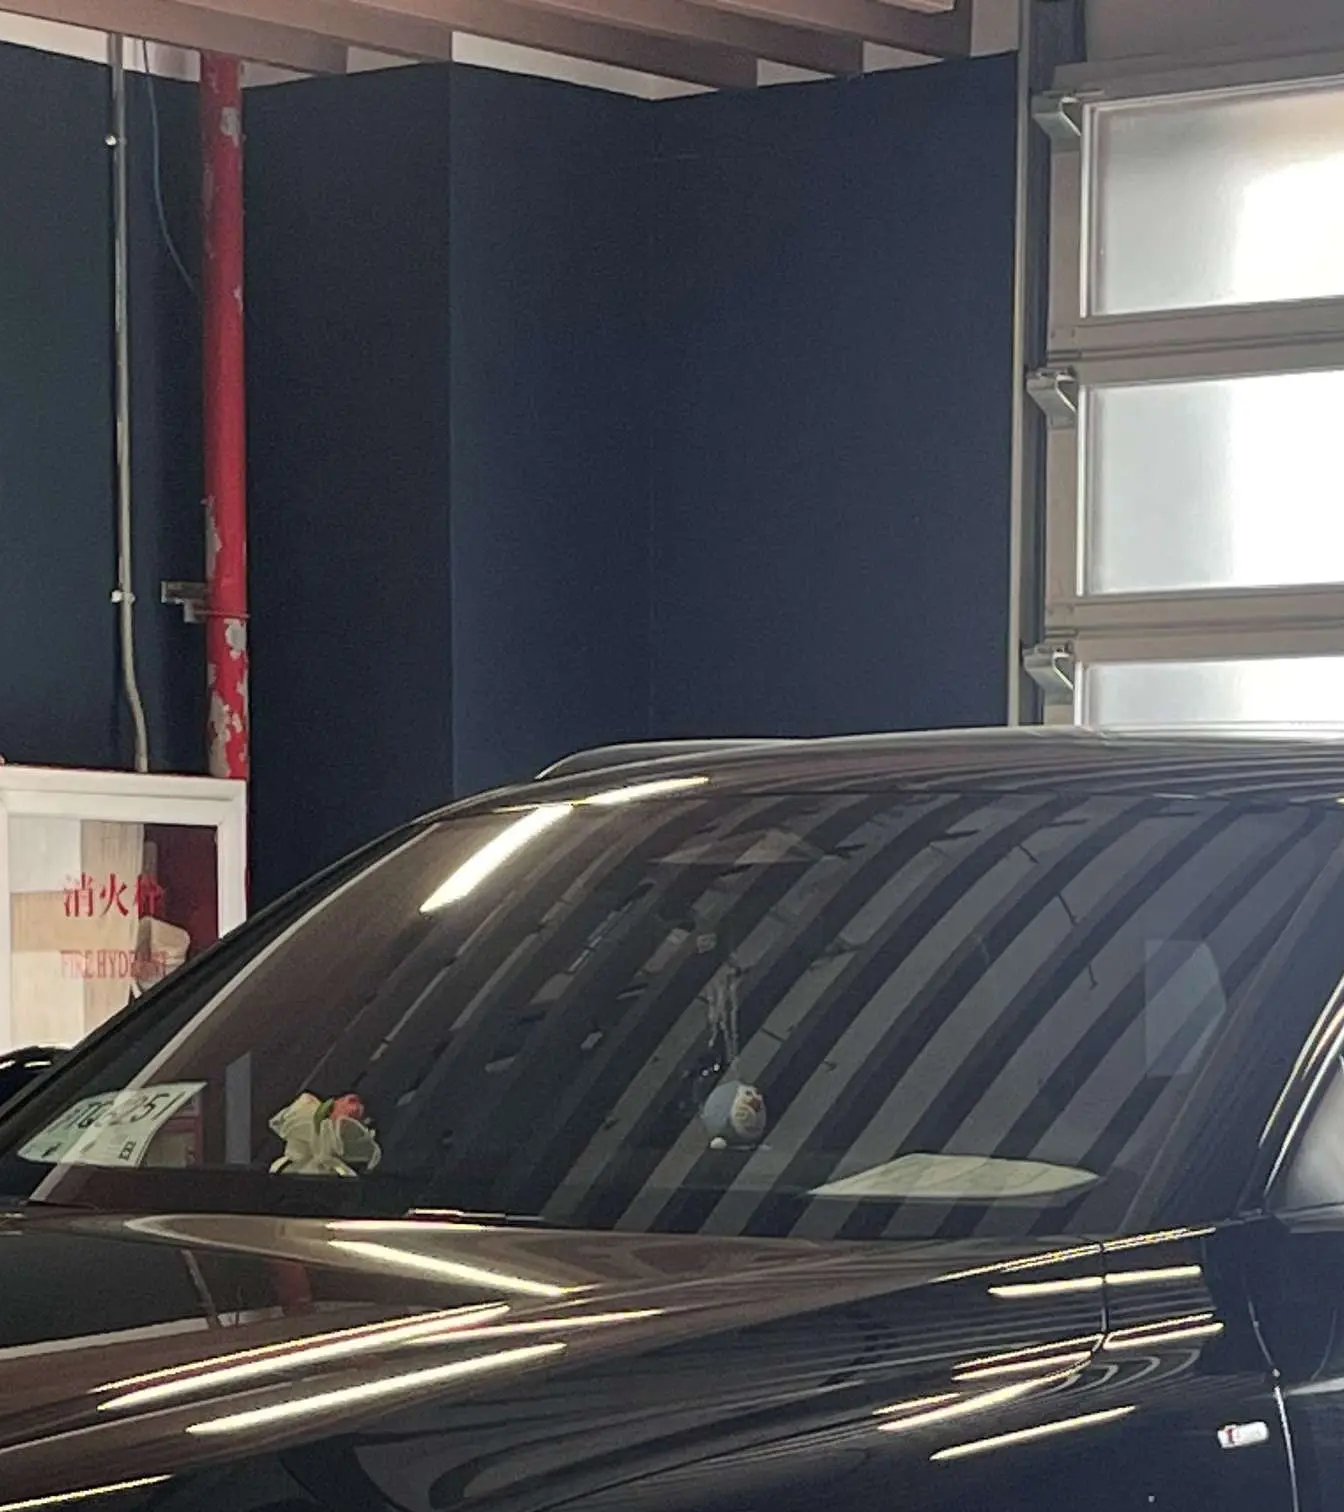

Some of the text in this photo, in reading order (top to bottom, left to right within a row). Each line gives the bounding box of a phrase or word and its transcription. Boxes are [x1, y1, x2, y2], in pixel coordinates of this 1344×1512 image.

[64, 873, 163, 918] 消火栓
[61, 948, 94, 979] FIRE
